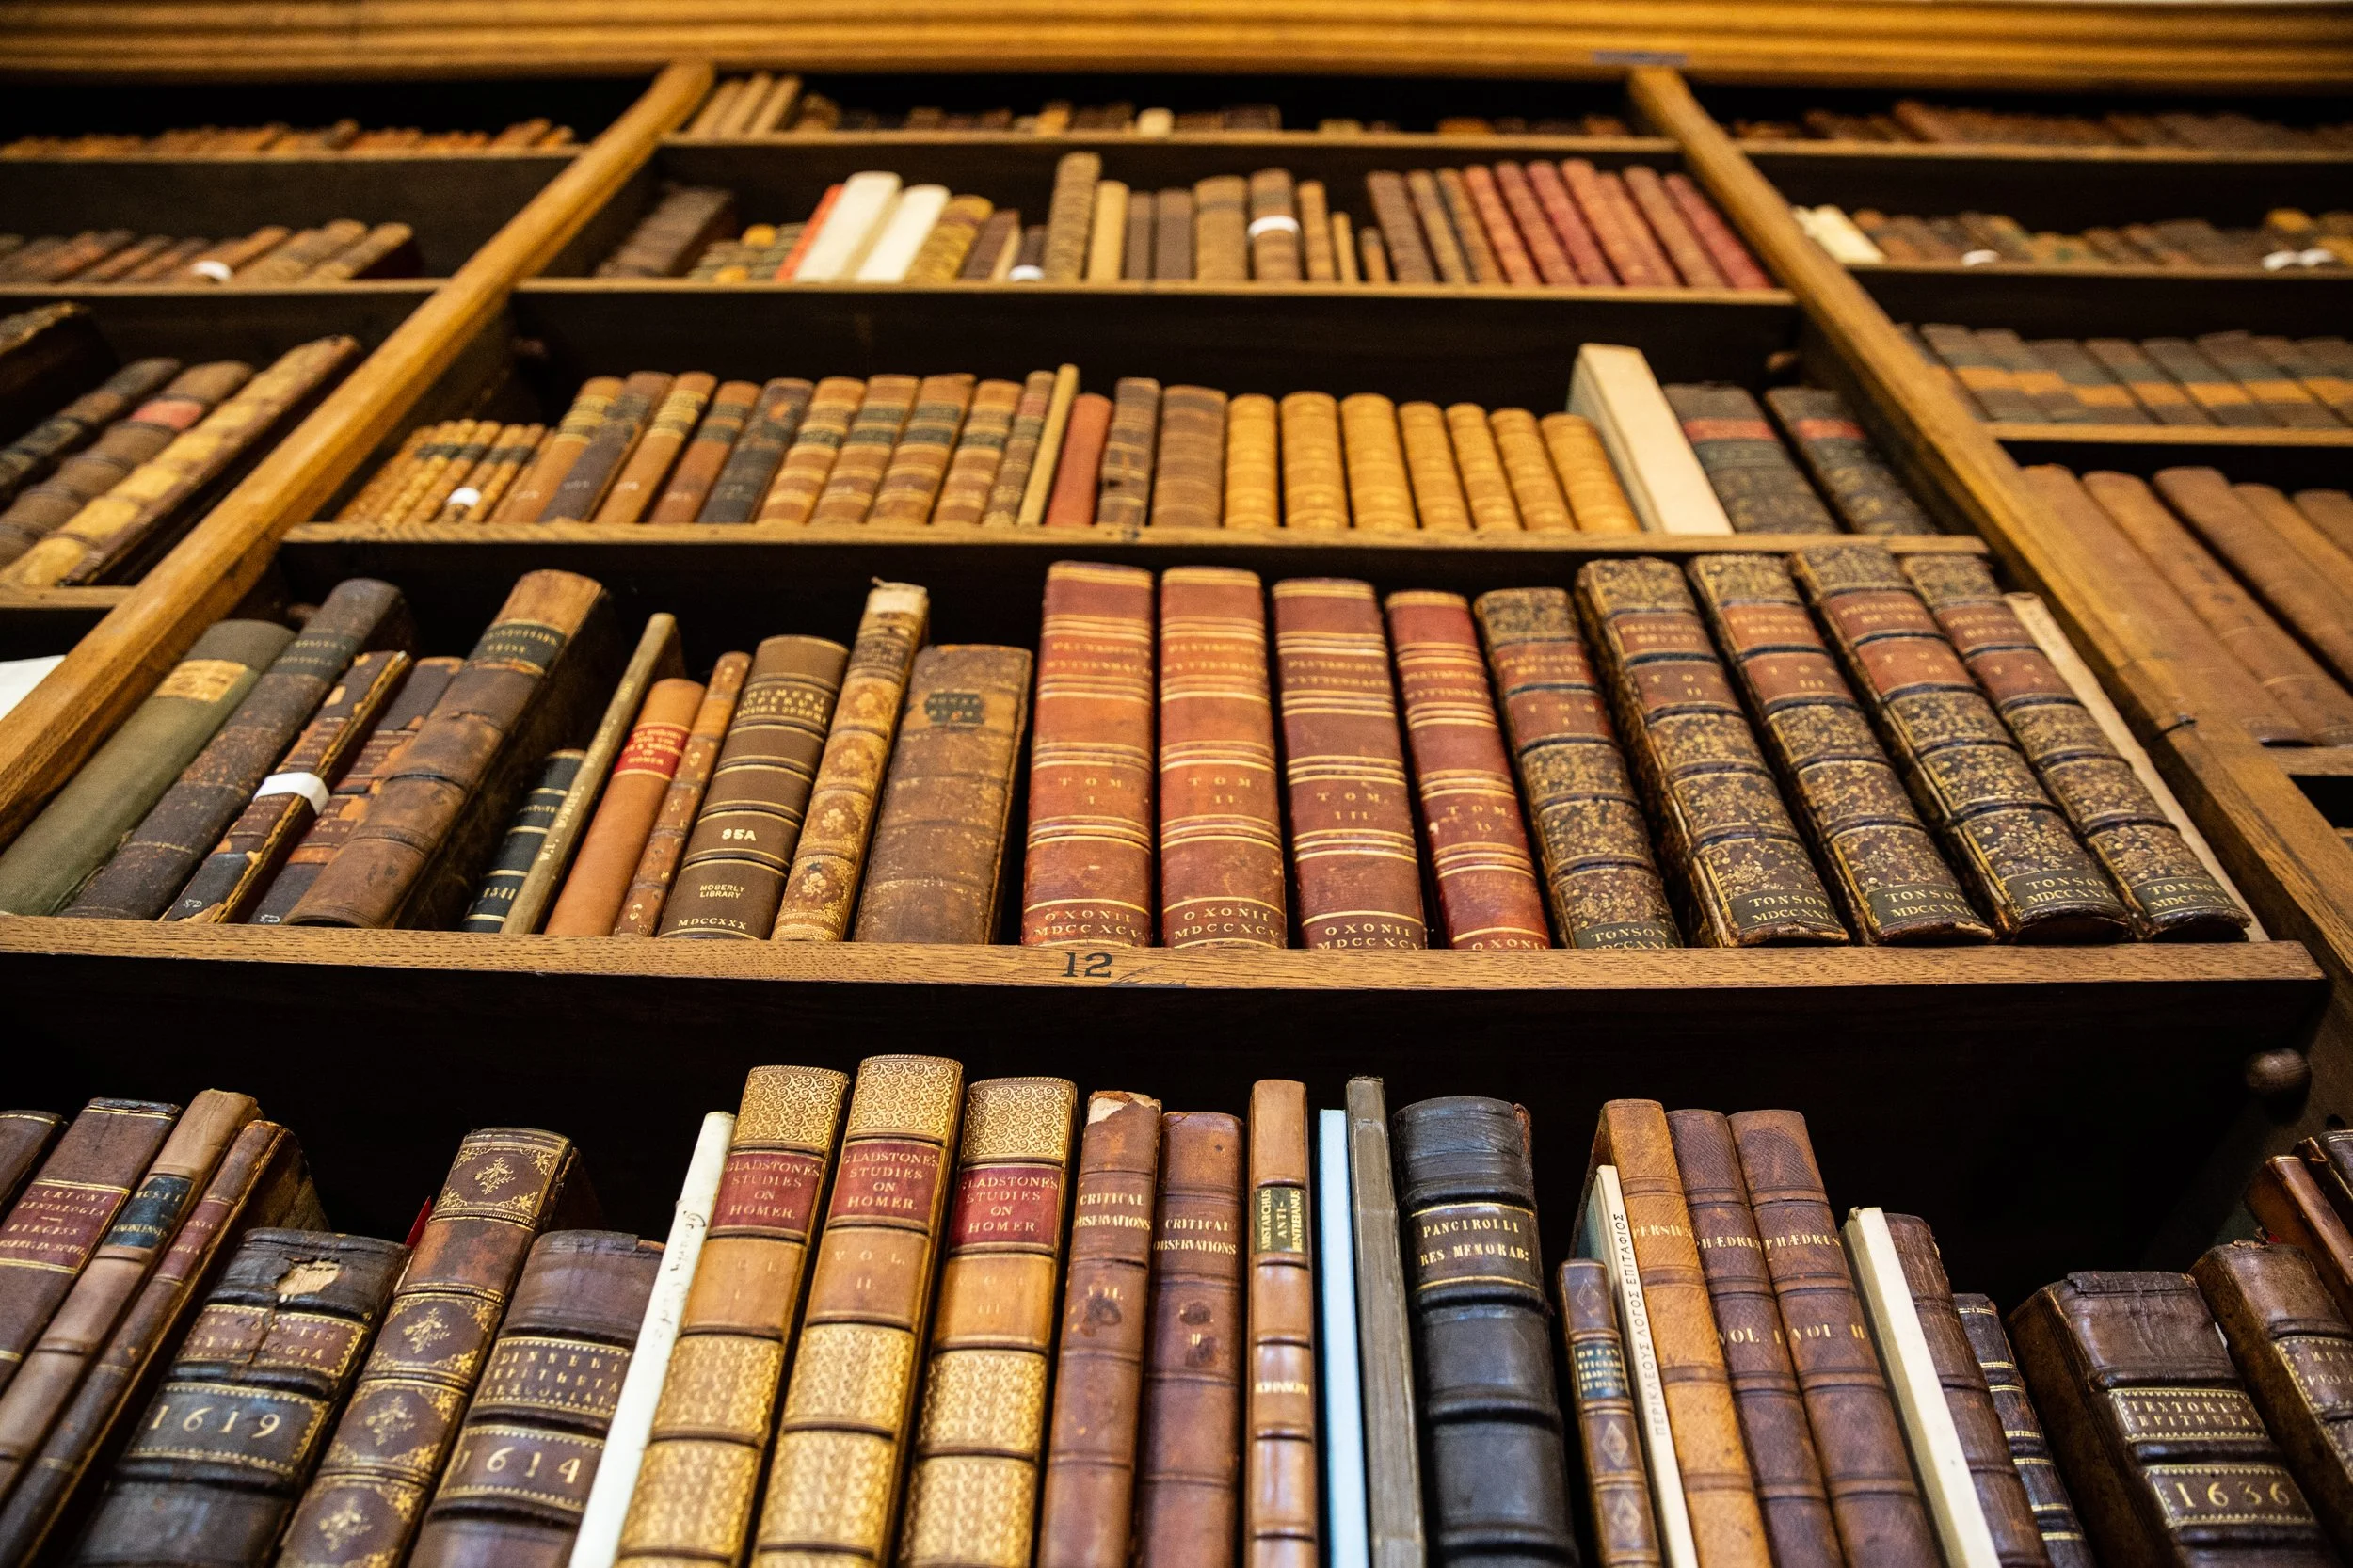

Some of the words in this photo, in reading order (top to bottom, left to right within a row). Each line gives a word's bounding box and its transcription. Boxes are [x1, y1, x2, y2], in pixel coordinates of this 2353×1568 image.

[699, 884, 745, 893] MOBERLY
[699, 890, 742, 900] LIBRARY
[1748, 894, 1829, 908] TONSON
[1044, 909, 1131, 922] OXONII
[1183, 906, 1271, 921] OXONII
[678, 917, 747, 931] MDCCXXX
[1324, 923, 1412, 937] OXONII
[1590, 927, 1669, 942] TONSON
[1061, 952, 1113, 979] 12
[842, 1151, 940, 1168] GLADSTONE'S
[726, 1160, 821, 1177] GLADSTONE'S
[849, 1166, 923, 1180] STUDIES
[731, 1176, 803, 1188] STUDIES
[872, 1181, 896, 1192] ON
[28, 1190, 109, 1204] URTONI
[754, 1190, 776, 1201] ON
[847, 1195, 918, 1211] HOMER.
[965, 1191, 1042, 1204] STUDIES
[1080, 1192, 1144, 1206] CRITICAL
[728, 1204, 797, 1220] HOMER.
[990, 1206, 1014, 1217] ON
[1073, 1213, 1152, 1231] OBSERVATIONS
[1165, 1218, 1230, 1232] CRITICAL
[1422, 1218, 1520, 1239] PANCIROLLI
[1632, 1224, 1694, 1240] PERSIUS
[1153, 1239, 1237, 1256] OBSERVATIONS
[1612, 1213, 1637, 1285] ΕΠΙΤΑΦΙΟΣ
[1696, 1235, 1762, 1253] HÆDRUS
[1764, 1233, 1842, 1251] PHÆDRUS
[834, 1249, 906, 1266] VOL.
[1419, 1248, 1446, 1267] RES
[1452, 1242, 1529, 1262] MEMORAB:
[1628, 1290, 1648, 1337] ΛΟΓΟΣ
[1773, 1329, 1782, 1345] I
[1849, 1324, 1866, 1340] II
[2129, 1400, 2242, 1414] TEXTORIS
[150, 1404, 281, 1438] 1619
[2137, 1414, 2250, 1428] EPITHETA
[2175, 1481, 2292, 1509] 1636
